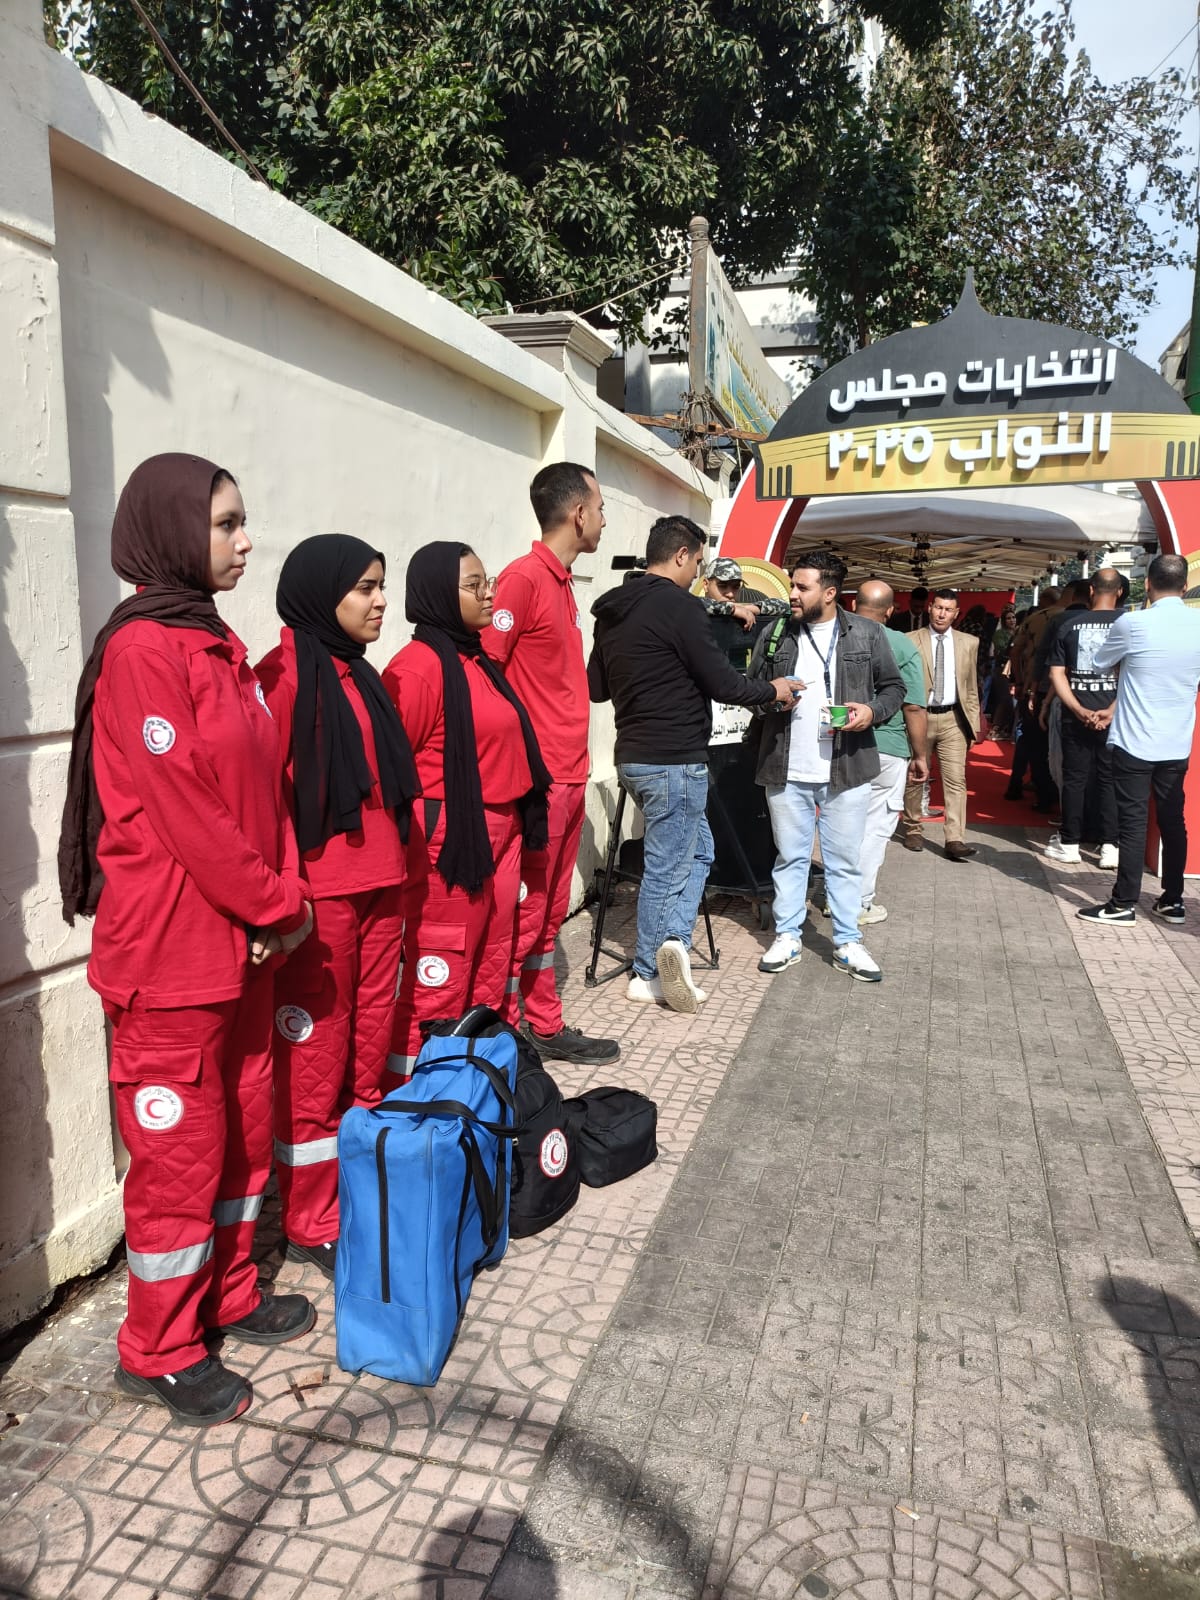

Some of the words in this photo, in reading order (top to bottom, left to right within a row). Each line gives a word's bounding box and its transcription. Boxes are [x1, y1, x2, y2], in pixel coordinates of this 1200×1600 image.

[829, 368, 947, 412] مجلس
[958, 348, 1118, 396] انتخابات
[829, 426, 934, 469] ٢٠٢٥
[949, 411, 1112, 471] النواب
